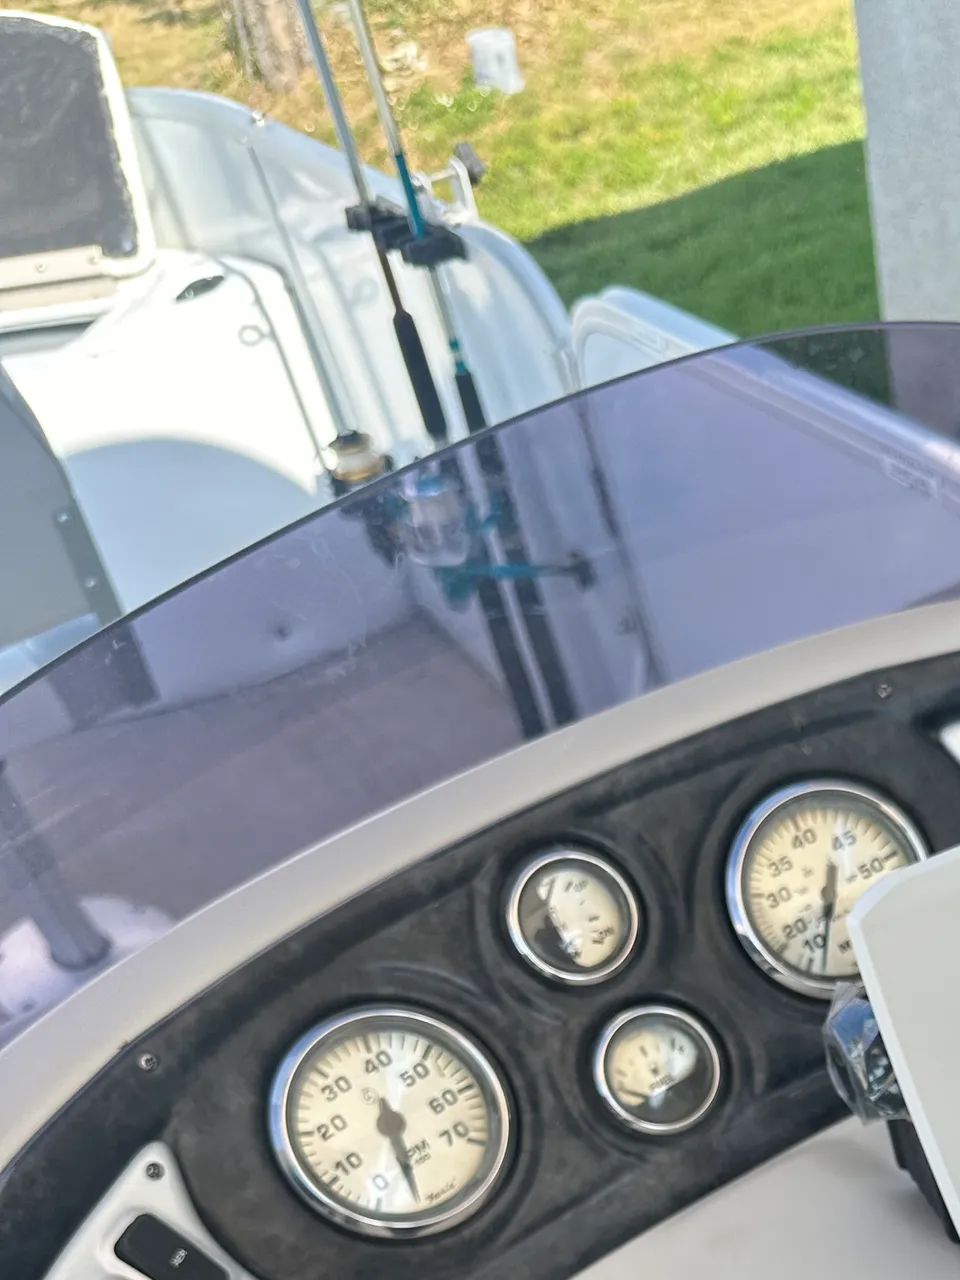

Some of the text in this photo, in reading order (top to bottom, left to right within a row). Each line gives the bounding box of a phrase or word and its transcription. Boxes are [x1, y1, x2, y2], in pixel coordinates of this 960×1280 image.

[791, 828, 817, 850] 40
[832, 831, 857, 852] 45
[767, 856, 793, 878] 35
[858, 857, 884, 880] 50
[767, 886, 792, 909] 30
[783, 918, 808, 941] 20
[803, 933, 826, 954] 10
[364, 1050, 393, 1076] 40
[400, 1061, 430, 1088] 50
[321, 1075, 352, 1102] 30
[428, 1089, 459, 1116] 60
[316, 1113, 348, 1142] 20
[439, 1121, 470, 1147] 70
[406, 1139, 430, 1160] PM
[335, 1152, 363, 1177] 10
[371, 1173, 390, 1192] 0
